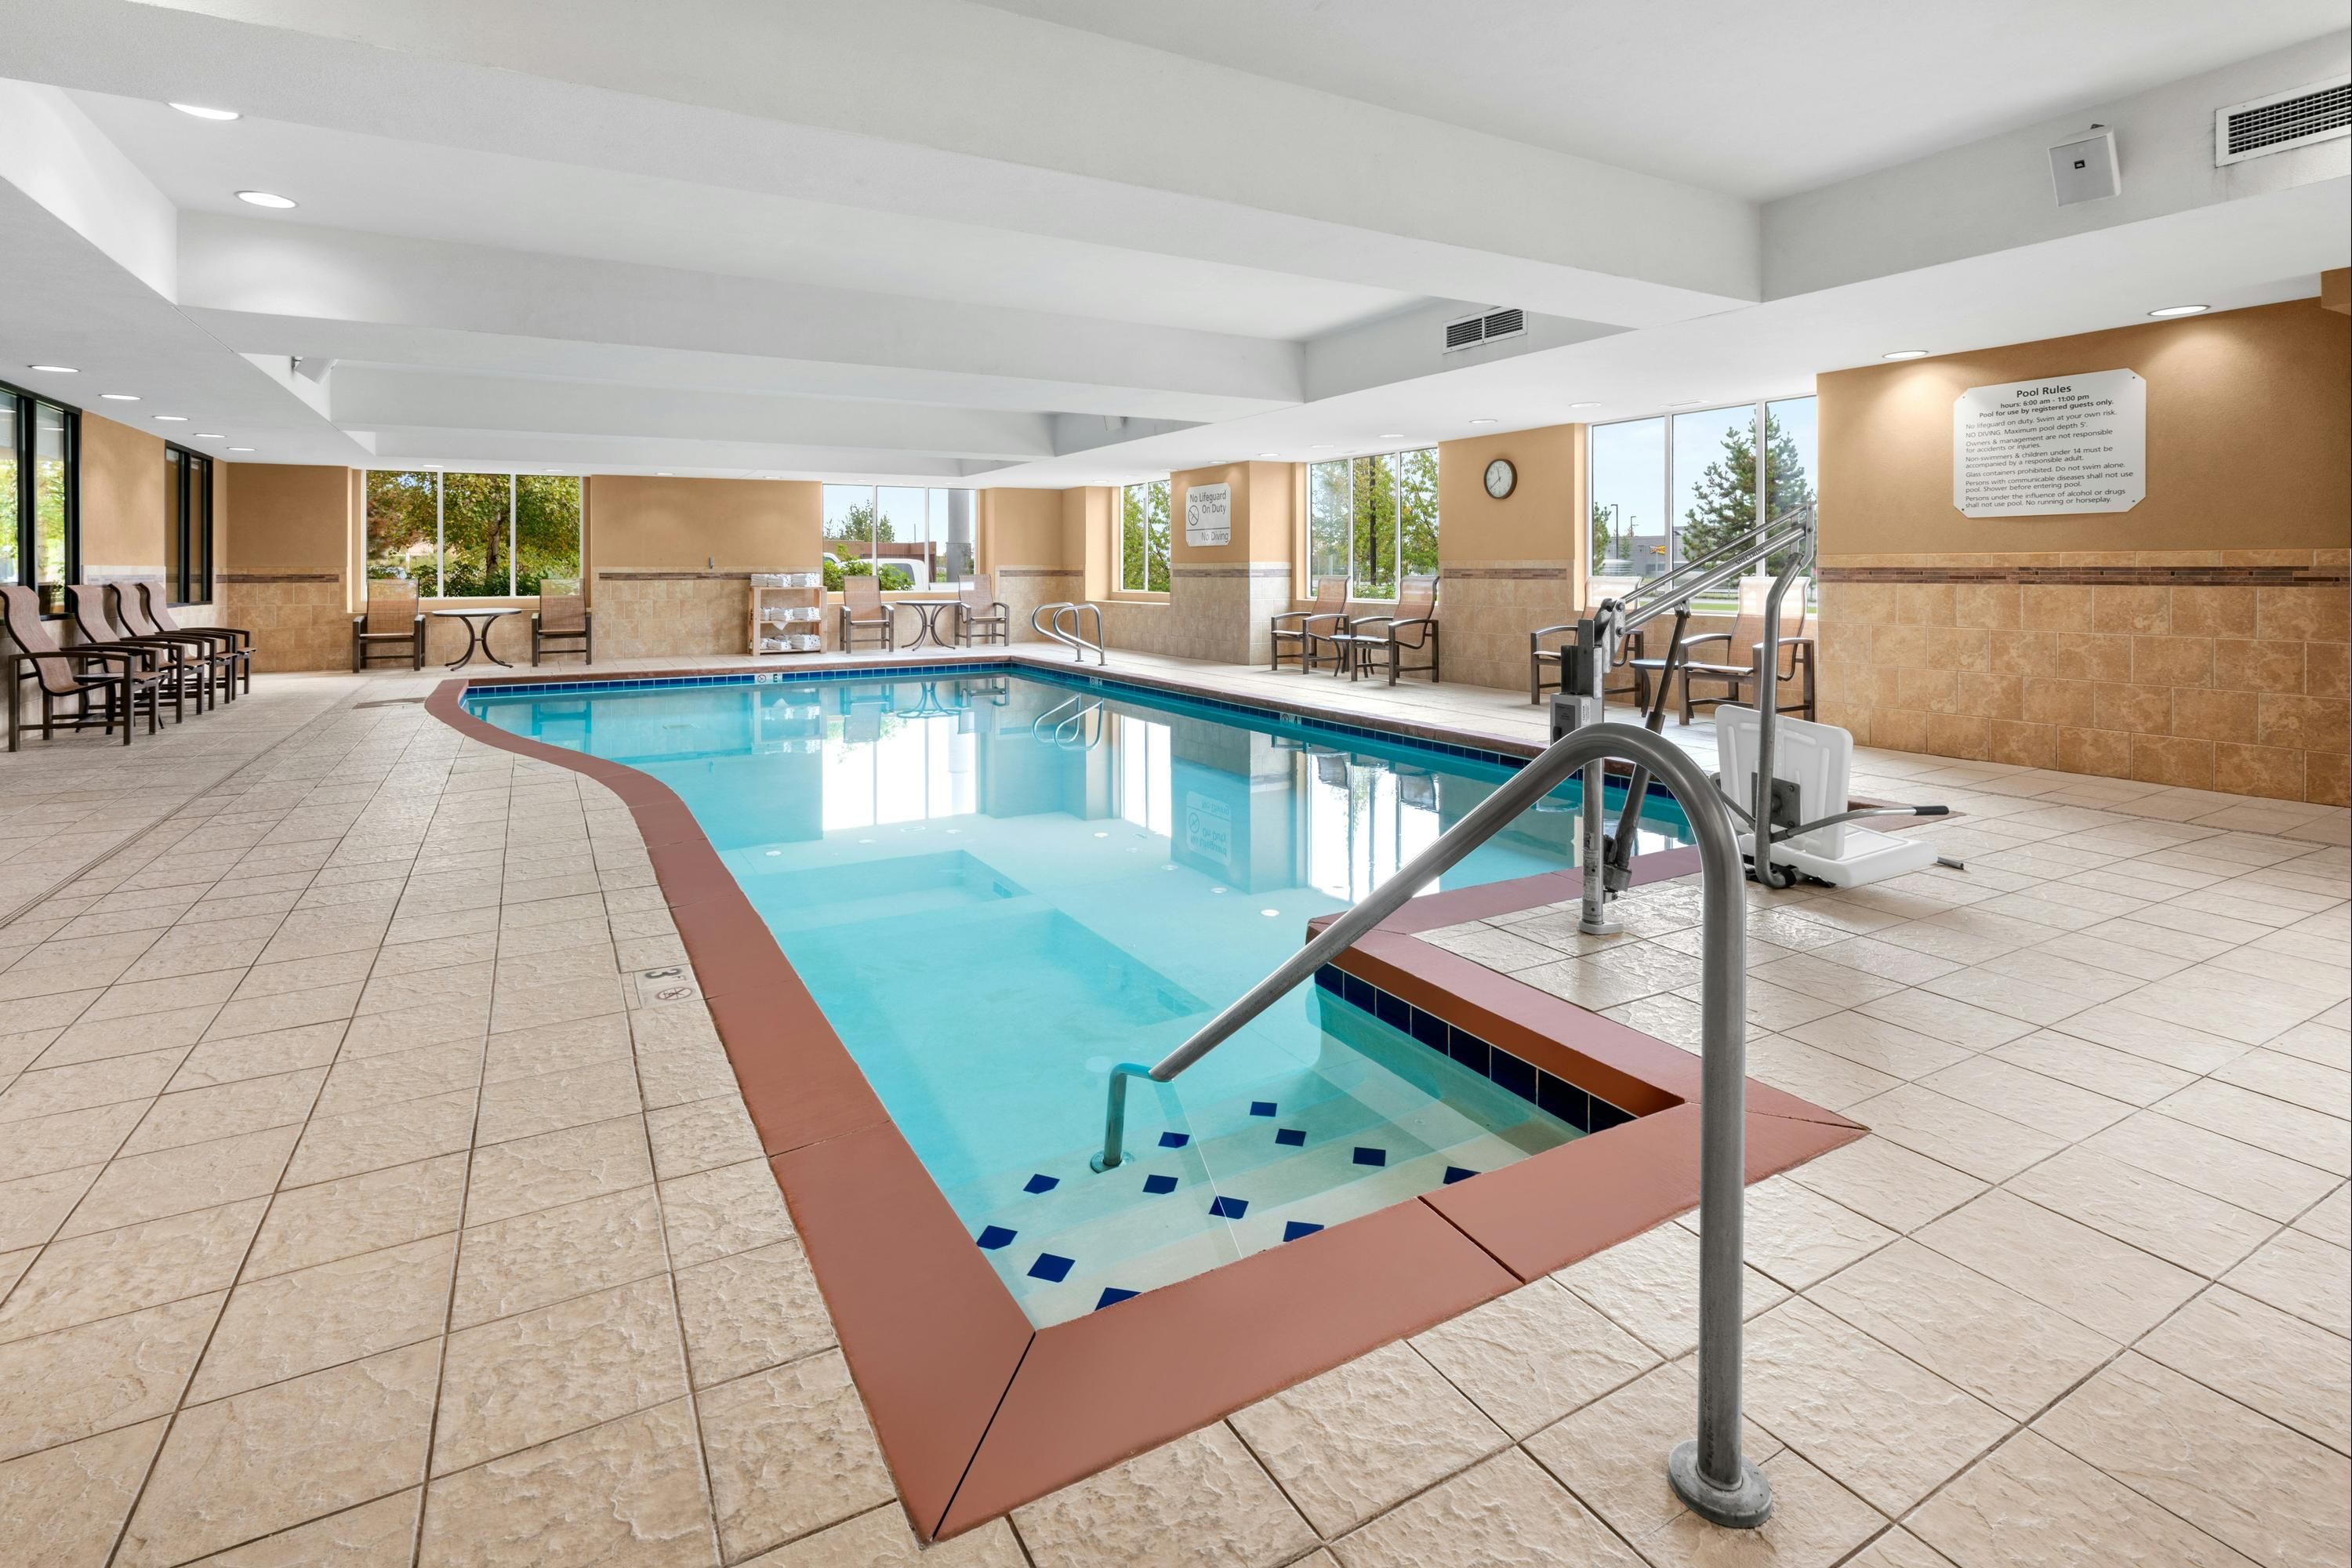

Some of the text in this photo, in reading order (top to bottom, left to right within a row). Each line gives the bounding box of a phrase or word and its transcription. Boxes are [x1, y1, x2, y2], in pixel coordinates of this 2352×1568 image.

[2016, 385, 2071, 398] Pool Rules
[2031, 403, 2067, 414] registered
[2069, 401, 2094, 411] guests
[2096, 398, 2114, 407] only.
[1976, 419, 2005, 429] lifeguard
[2065, 413, 2083, 422] your
[2038, 424, 2055, 434] pool
[2056, 422, 2078, 431] depth
[1999, 435, 2044, 445] management
[2072, 428, 2114, 438] responsible
[1965, 459, 2007, 469] accompanied
[2024, 456, 2063, 466] responsible
[2007, 475, 2056, 485] communicable
[1189, 490, 1226, 503] No Lifeguard
[1202, 504, 1226, 514] On Duty
[1201, 531, 1229, 543] No Diving
[644, 968, 682, 979] 3
